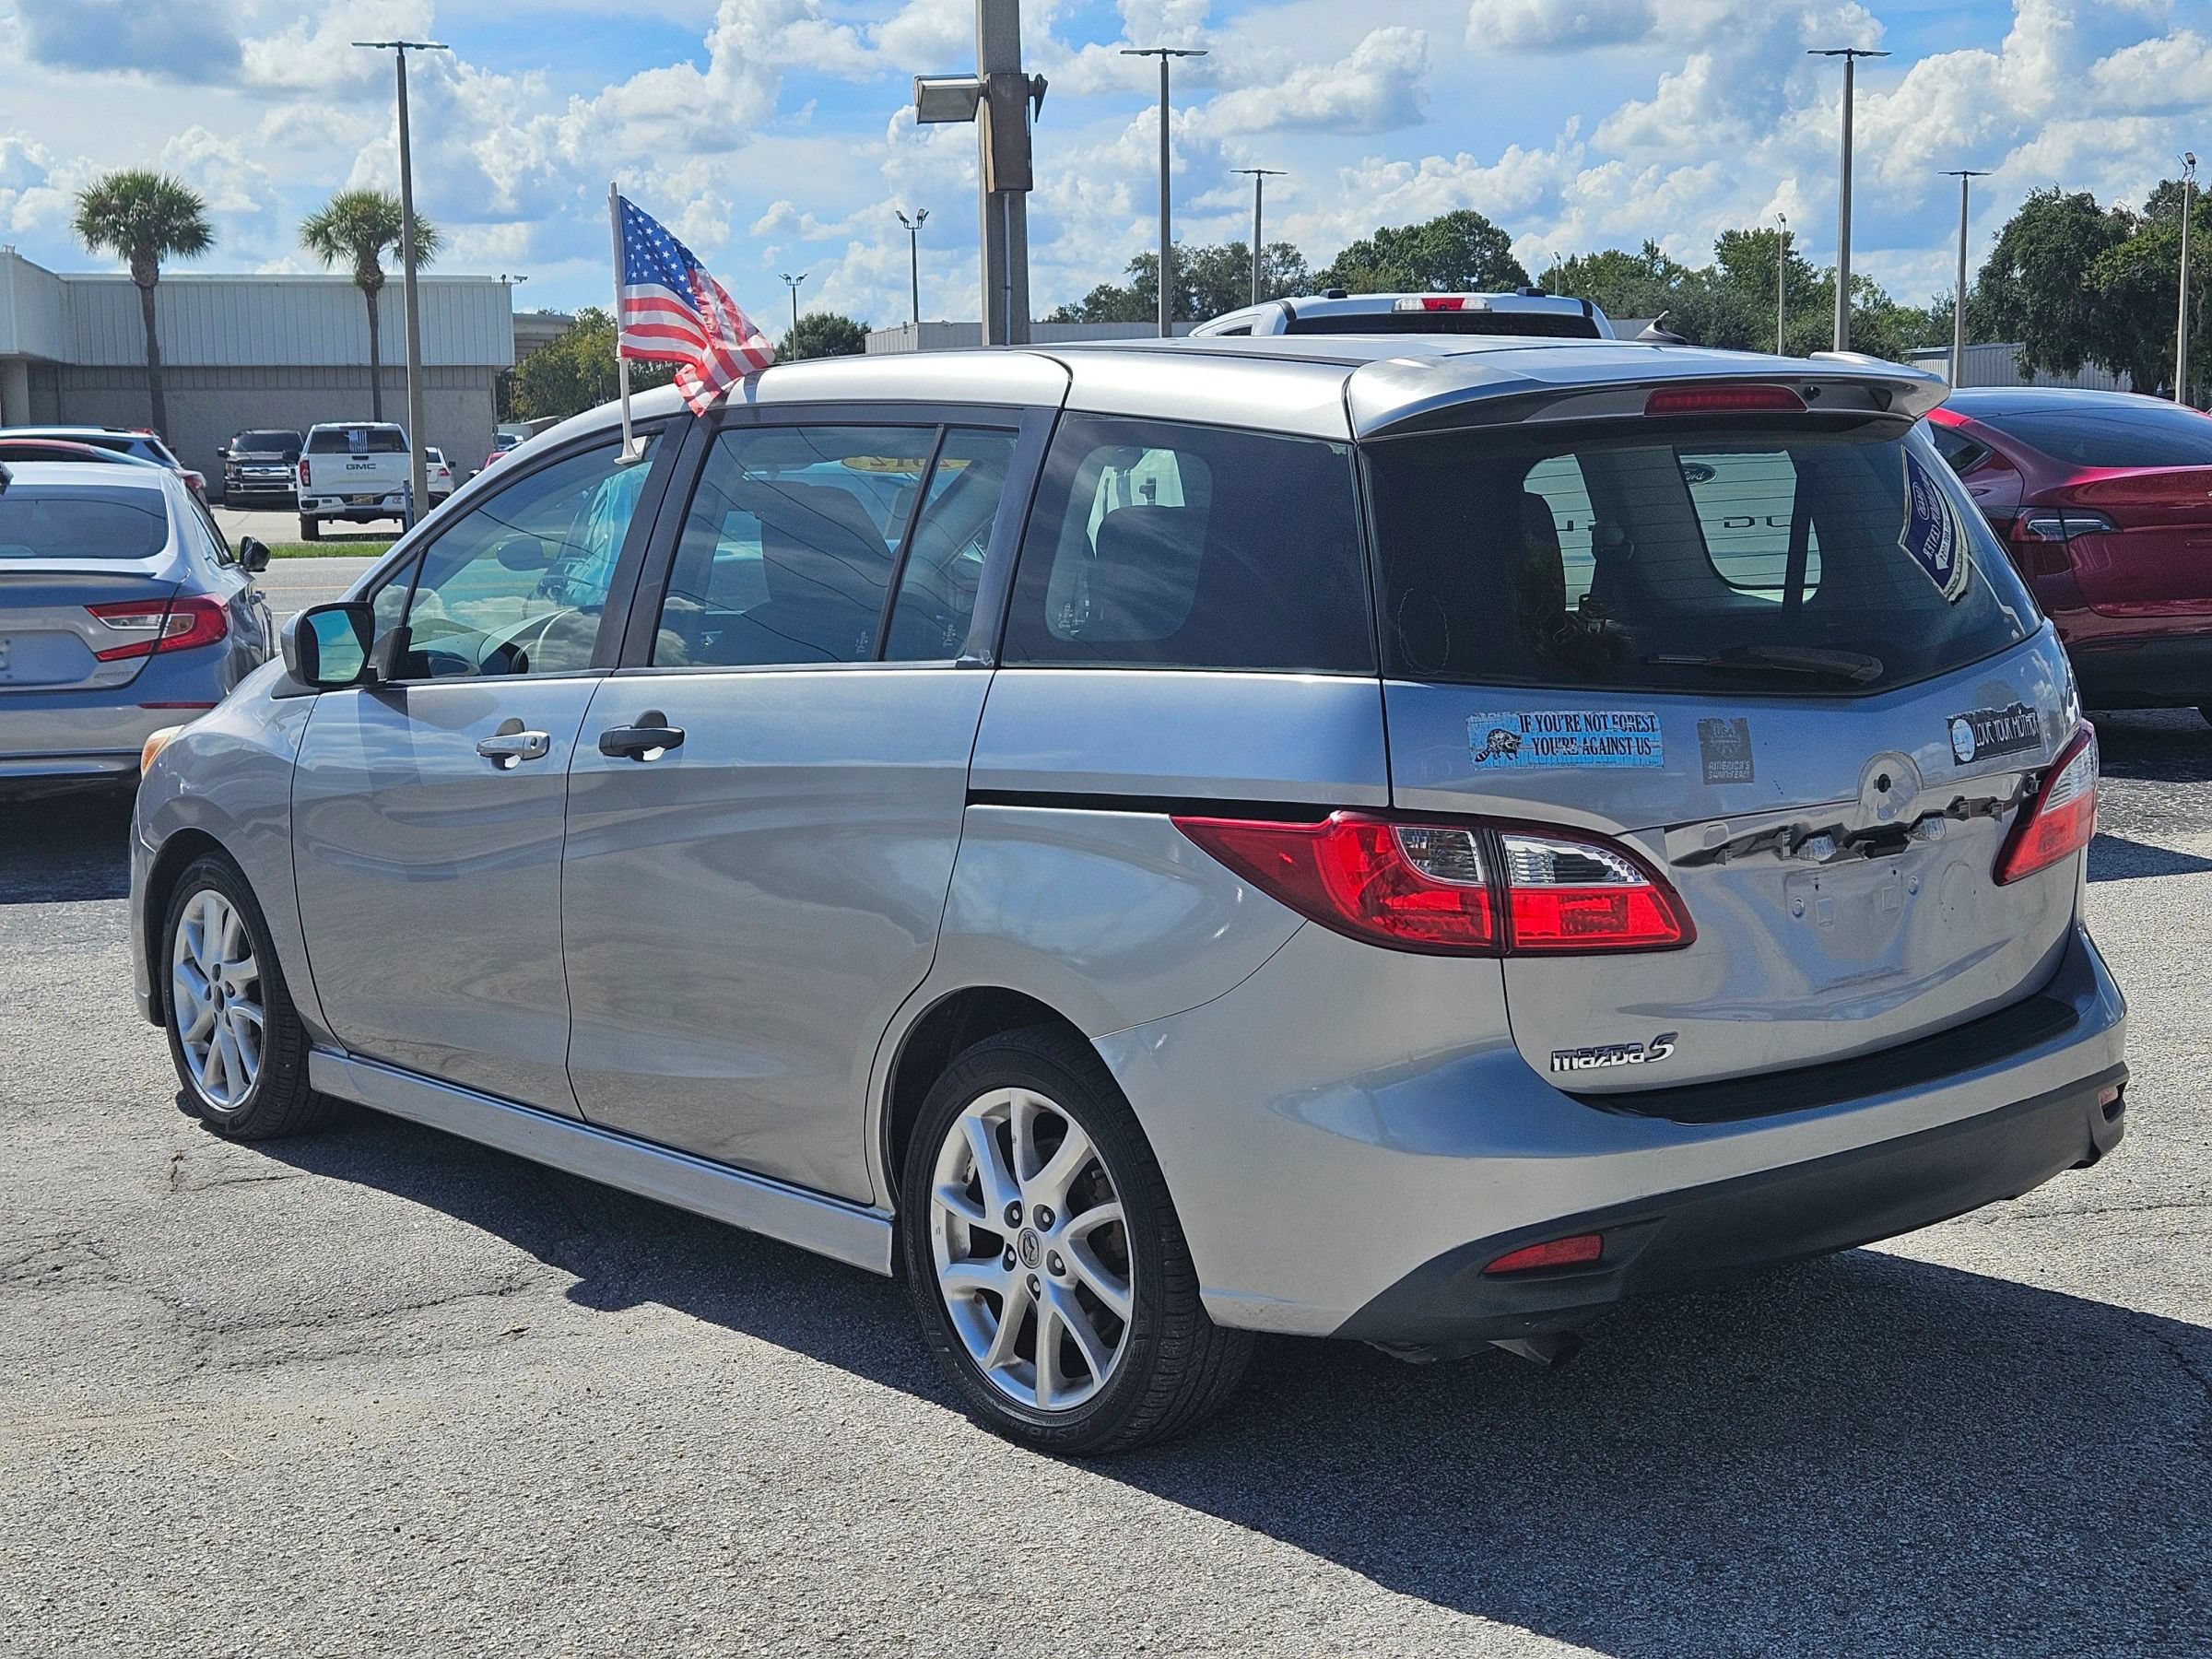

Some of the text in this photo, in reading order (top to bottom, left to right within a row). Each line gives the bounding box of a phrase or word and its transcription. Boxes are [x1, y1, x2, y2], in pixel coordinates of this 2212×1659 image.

[1520, 713, 1656, 734] IF YOU'RE NOT FOREST
[1972, 722, 1994, 747] LOVE
[1993, 717, 2014, 742] YOUR
[1531, 736, 1653, 756] YOU'RE AGAINST US
